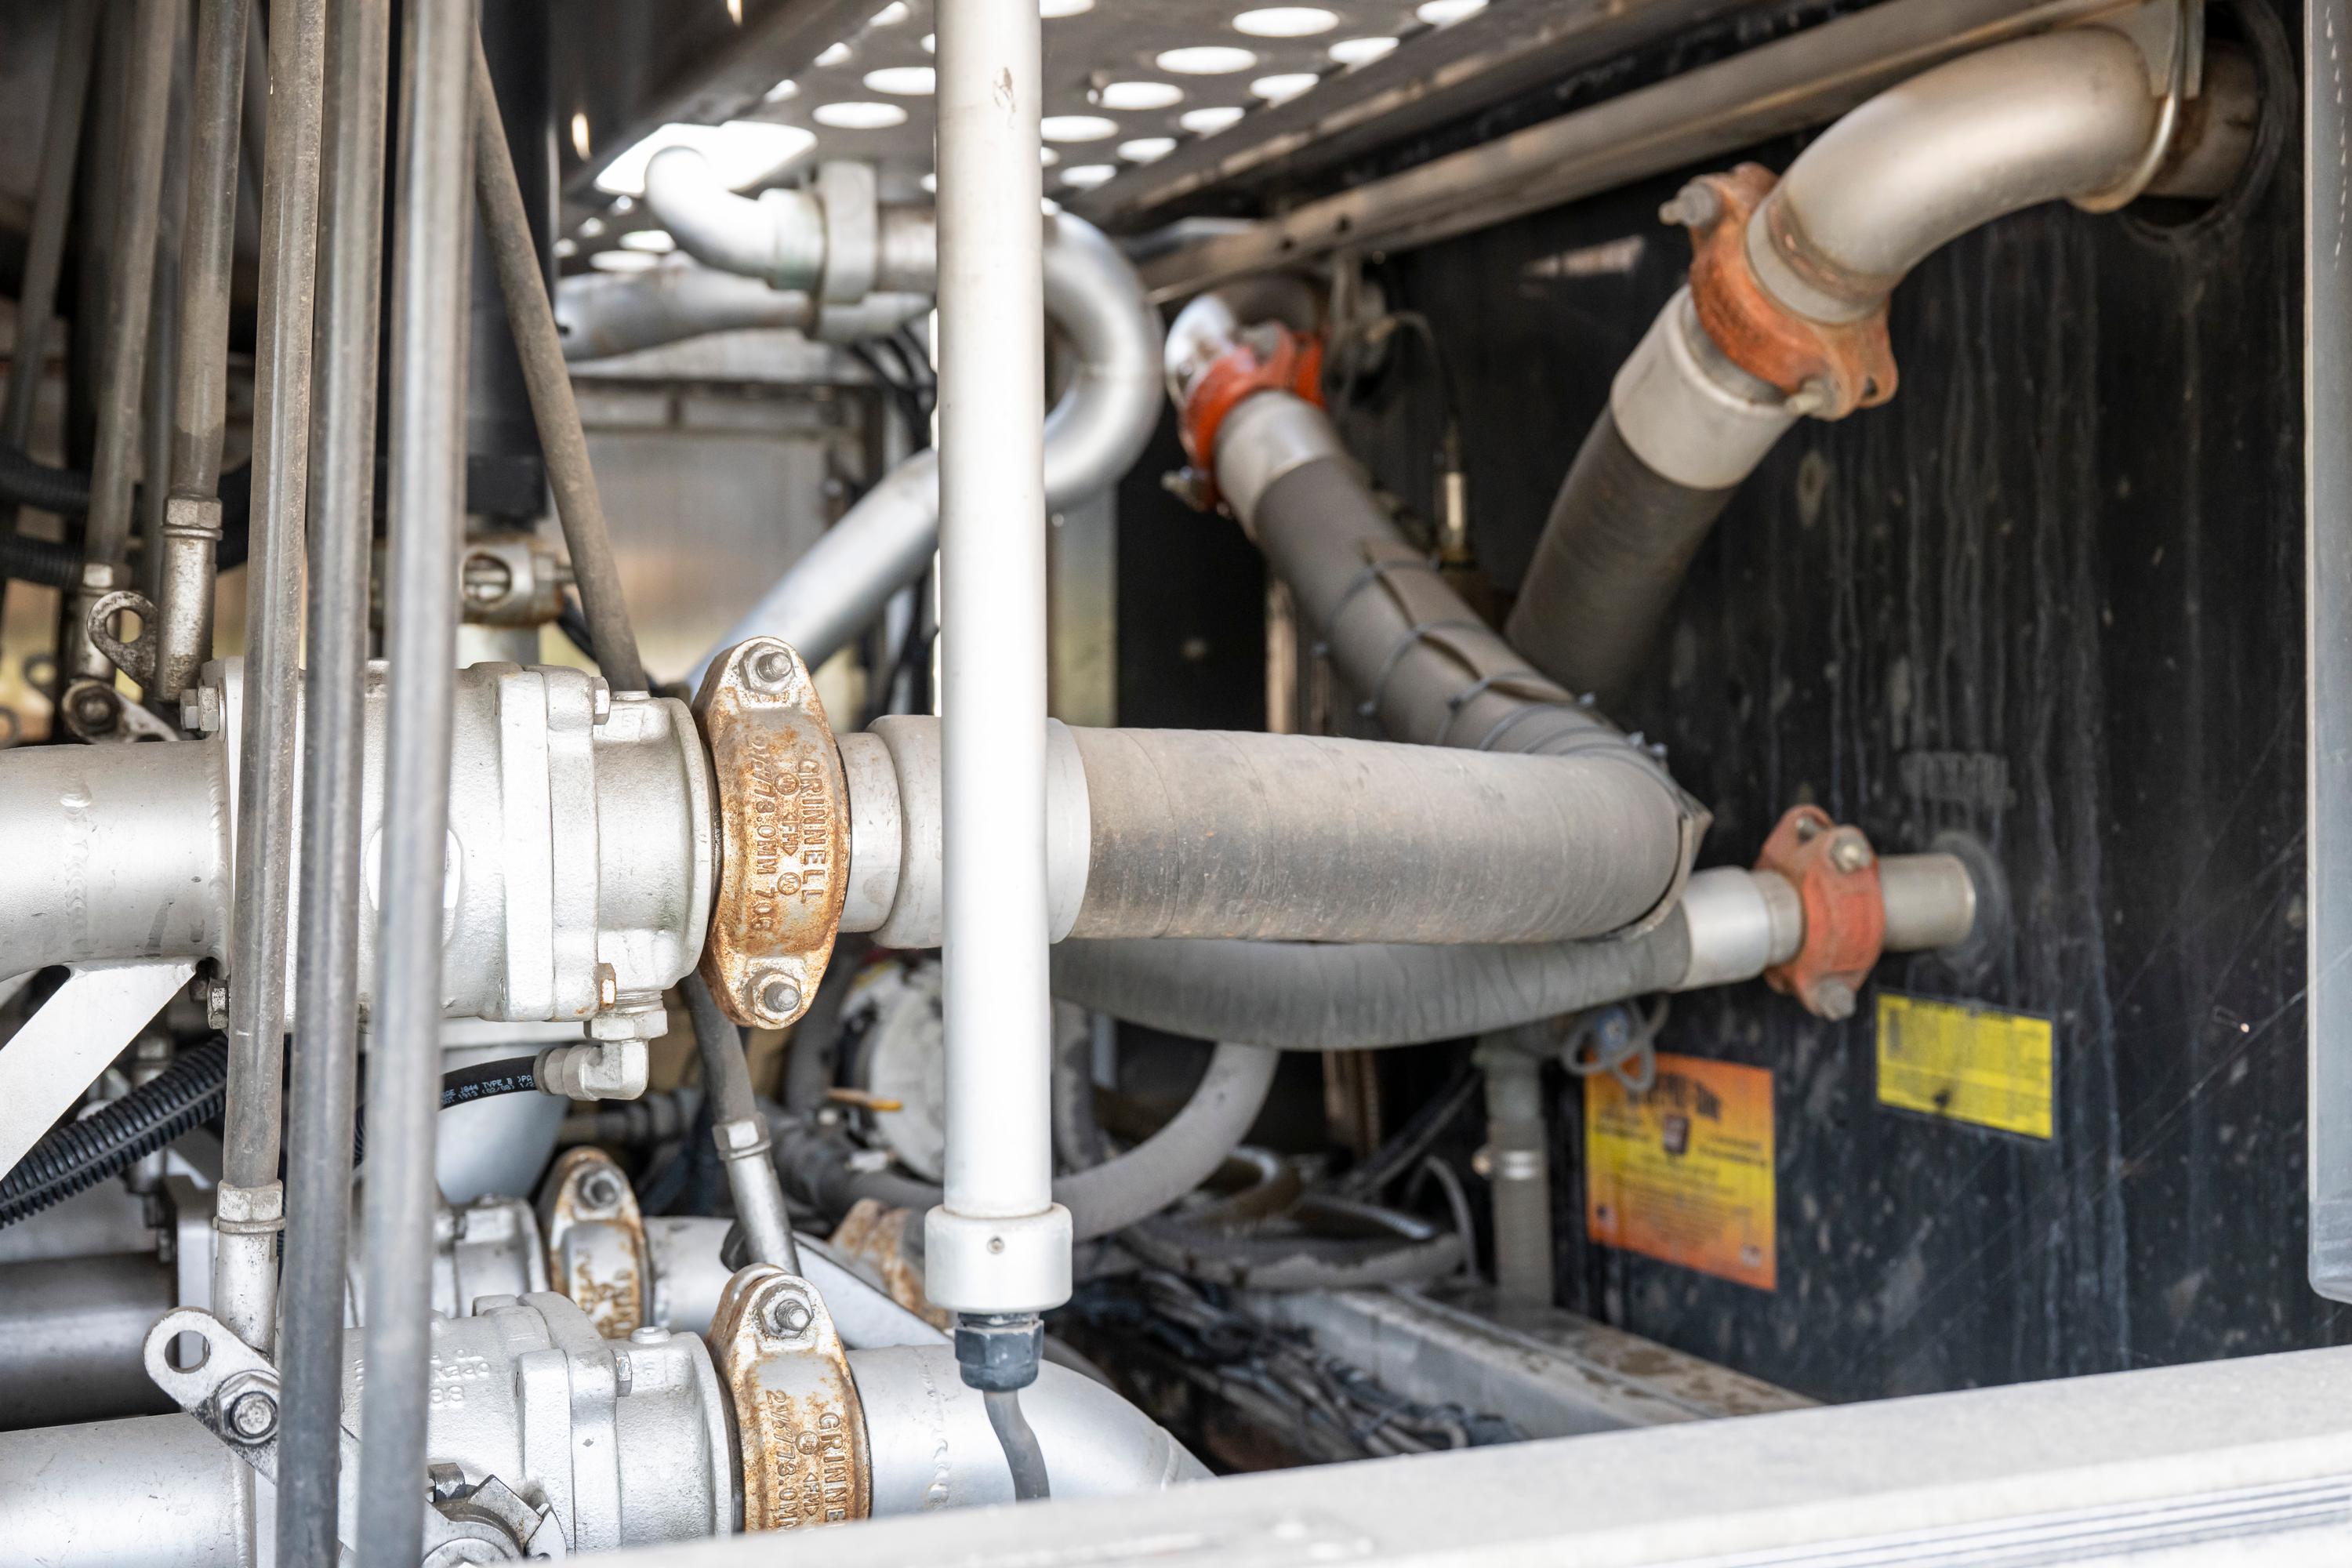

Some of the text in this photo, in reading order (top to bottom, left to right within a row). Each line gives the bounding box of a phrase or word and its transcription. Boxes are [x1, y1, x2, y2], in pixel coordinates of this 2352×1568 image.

[798, 757, 827, 904] GRINNELL
[482, 1079, 503, 1089] TYPE
[818, 1412, 848, 1523] GRINNE
